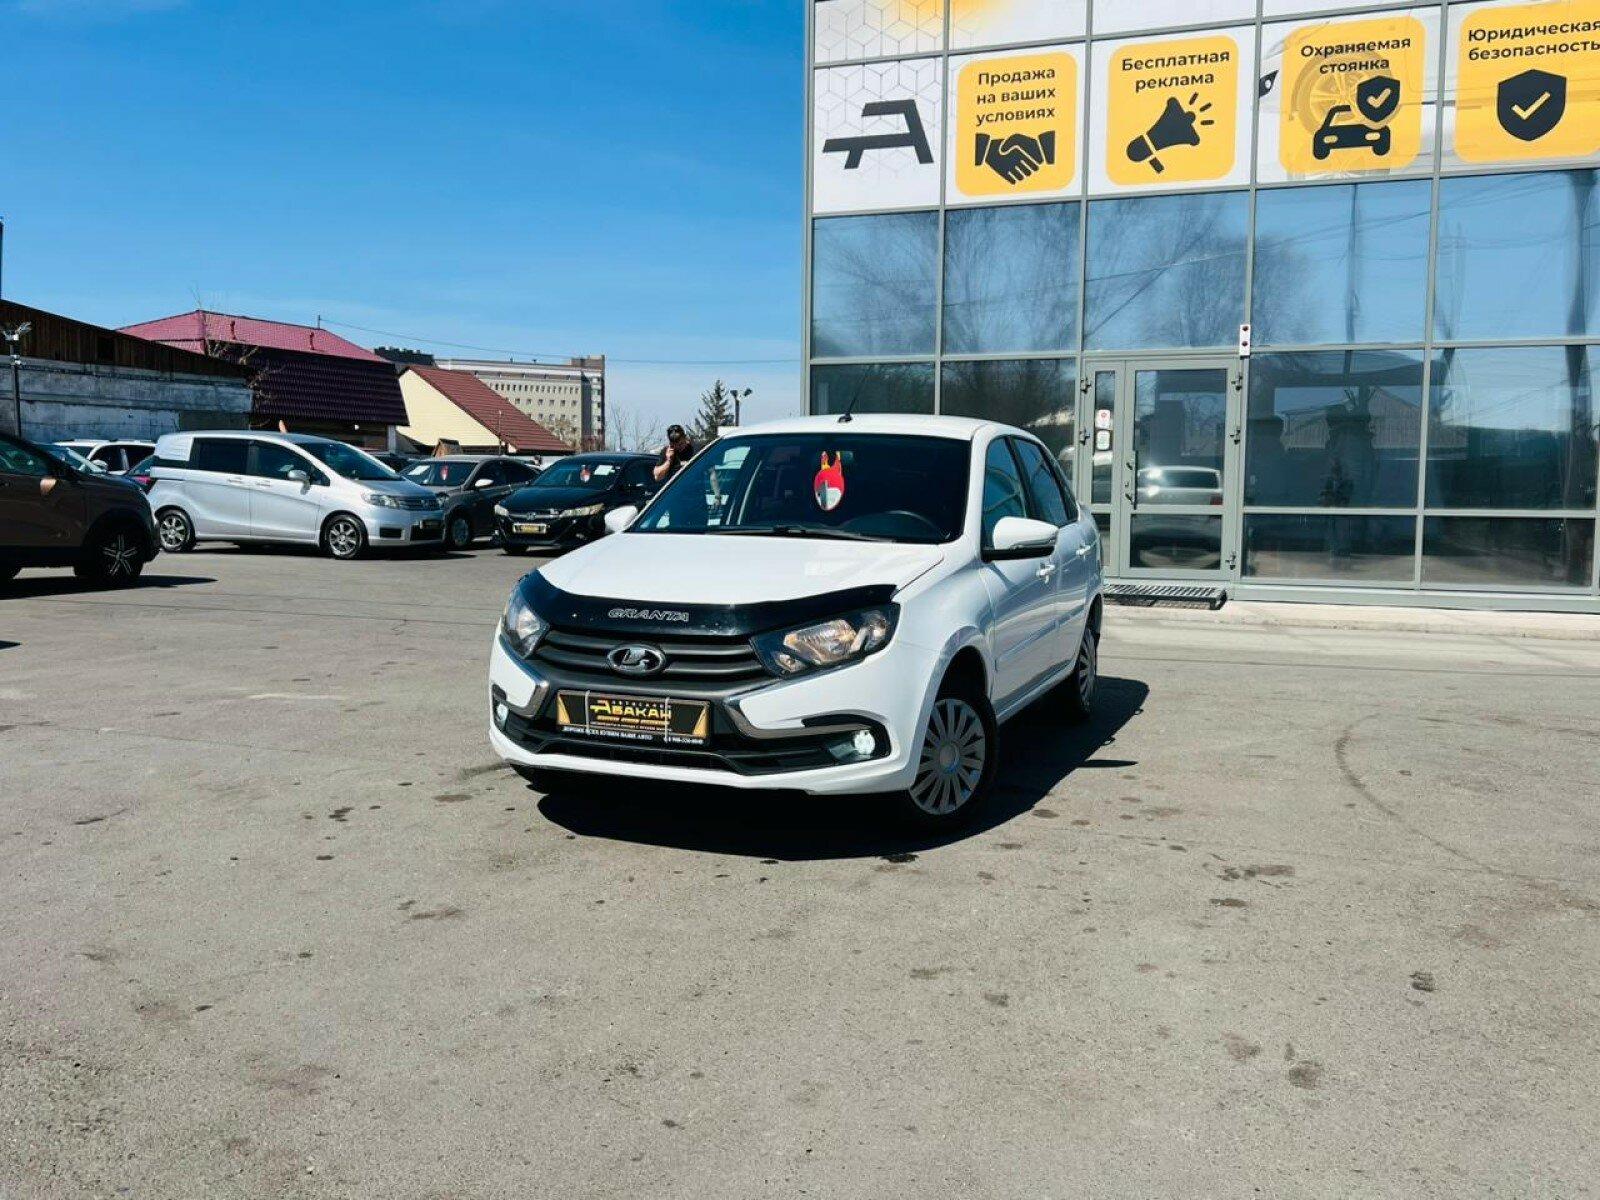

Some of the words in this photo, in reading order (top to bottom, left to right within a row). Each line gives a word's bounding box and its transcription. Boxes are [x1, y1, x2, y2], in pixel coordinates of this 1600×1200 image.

[1468, 20, 1600, 42] Юридическая
[1300, 38, 1411, 58] Охраняемая
[1468, 41, 1600, 60] безопасность
[1121, 51, 1230, 71] Бесплатная
[1320, 59, 1389, 74] стоянка
[978, 68, 1055, 86] Продажа
[1135, 73, 1215, 93] реклама
[976, 93, 996, 105] на
[1001, 88, 1056, 102] ваших
[976, 107, 1055, 126] условиях
[608, 608, 690, 622] GRANTA
